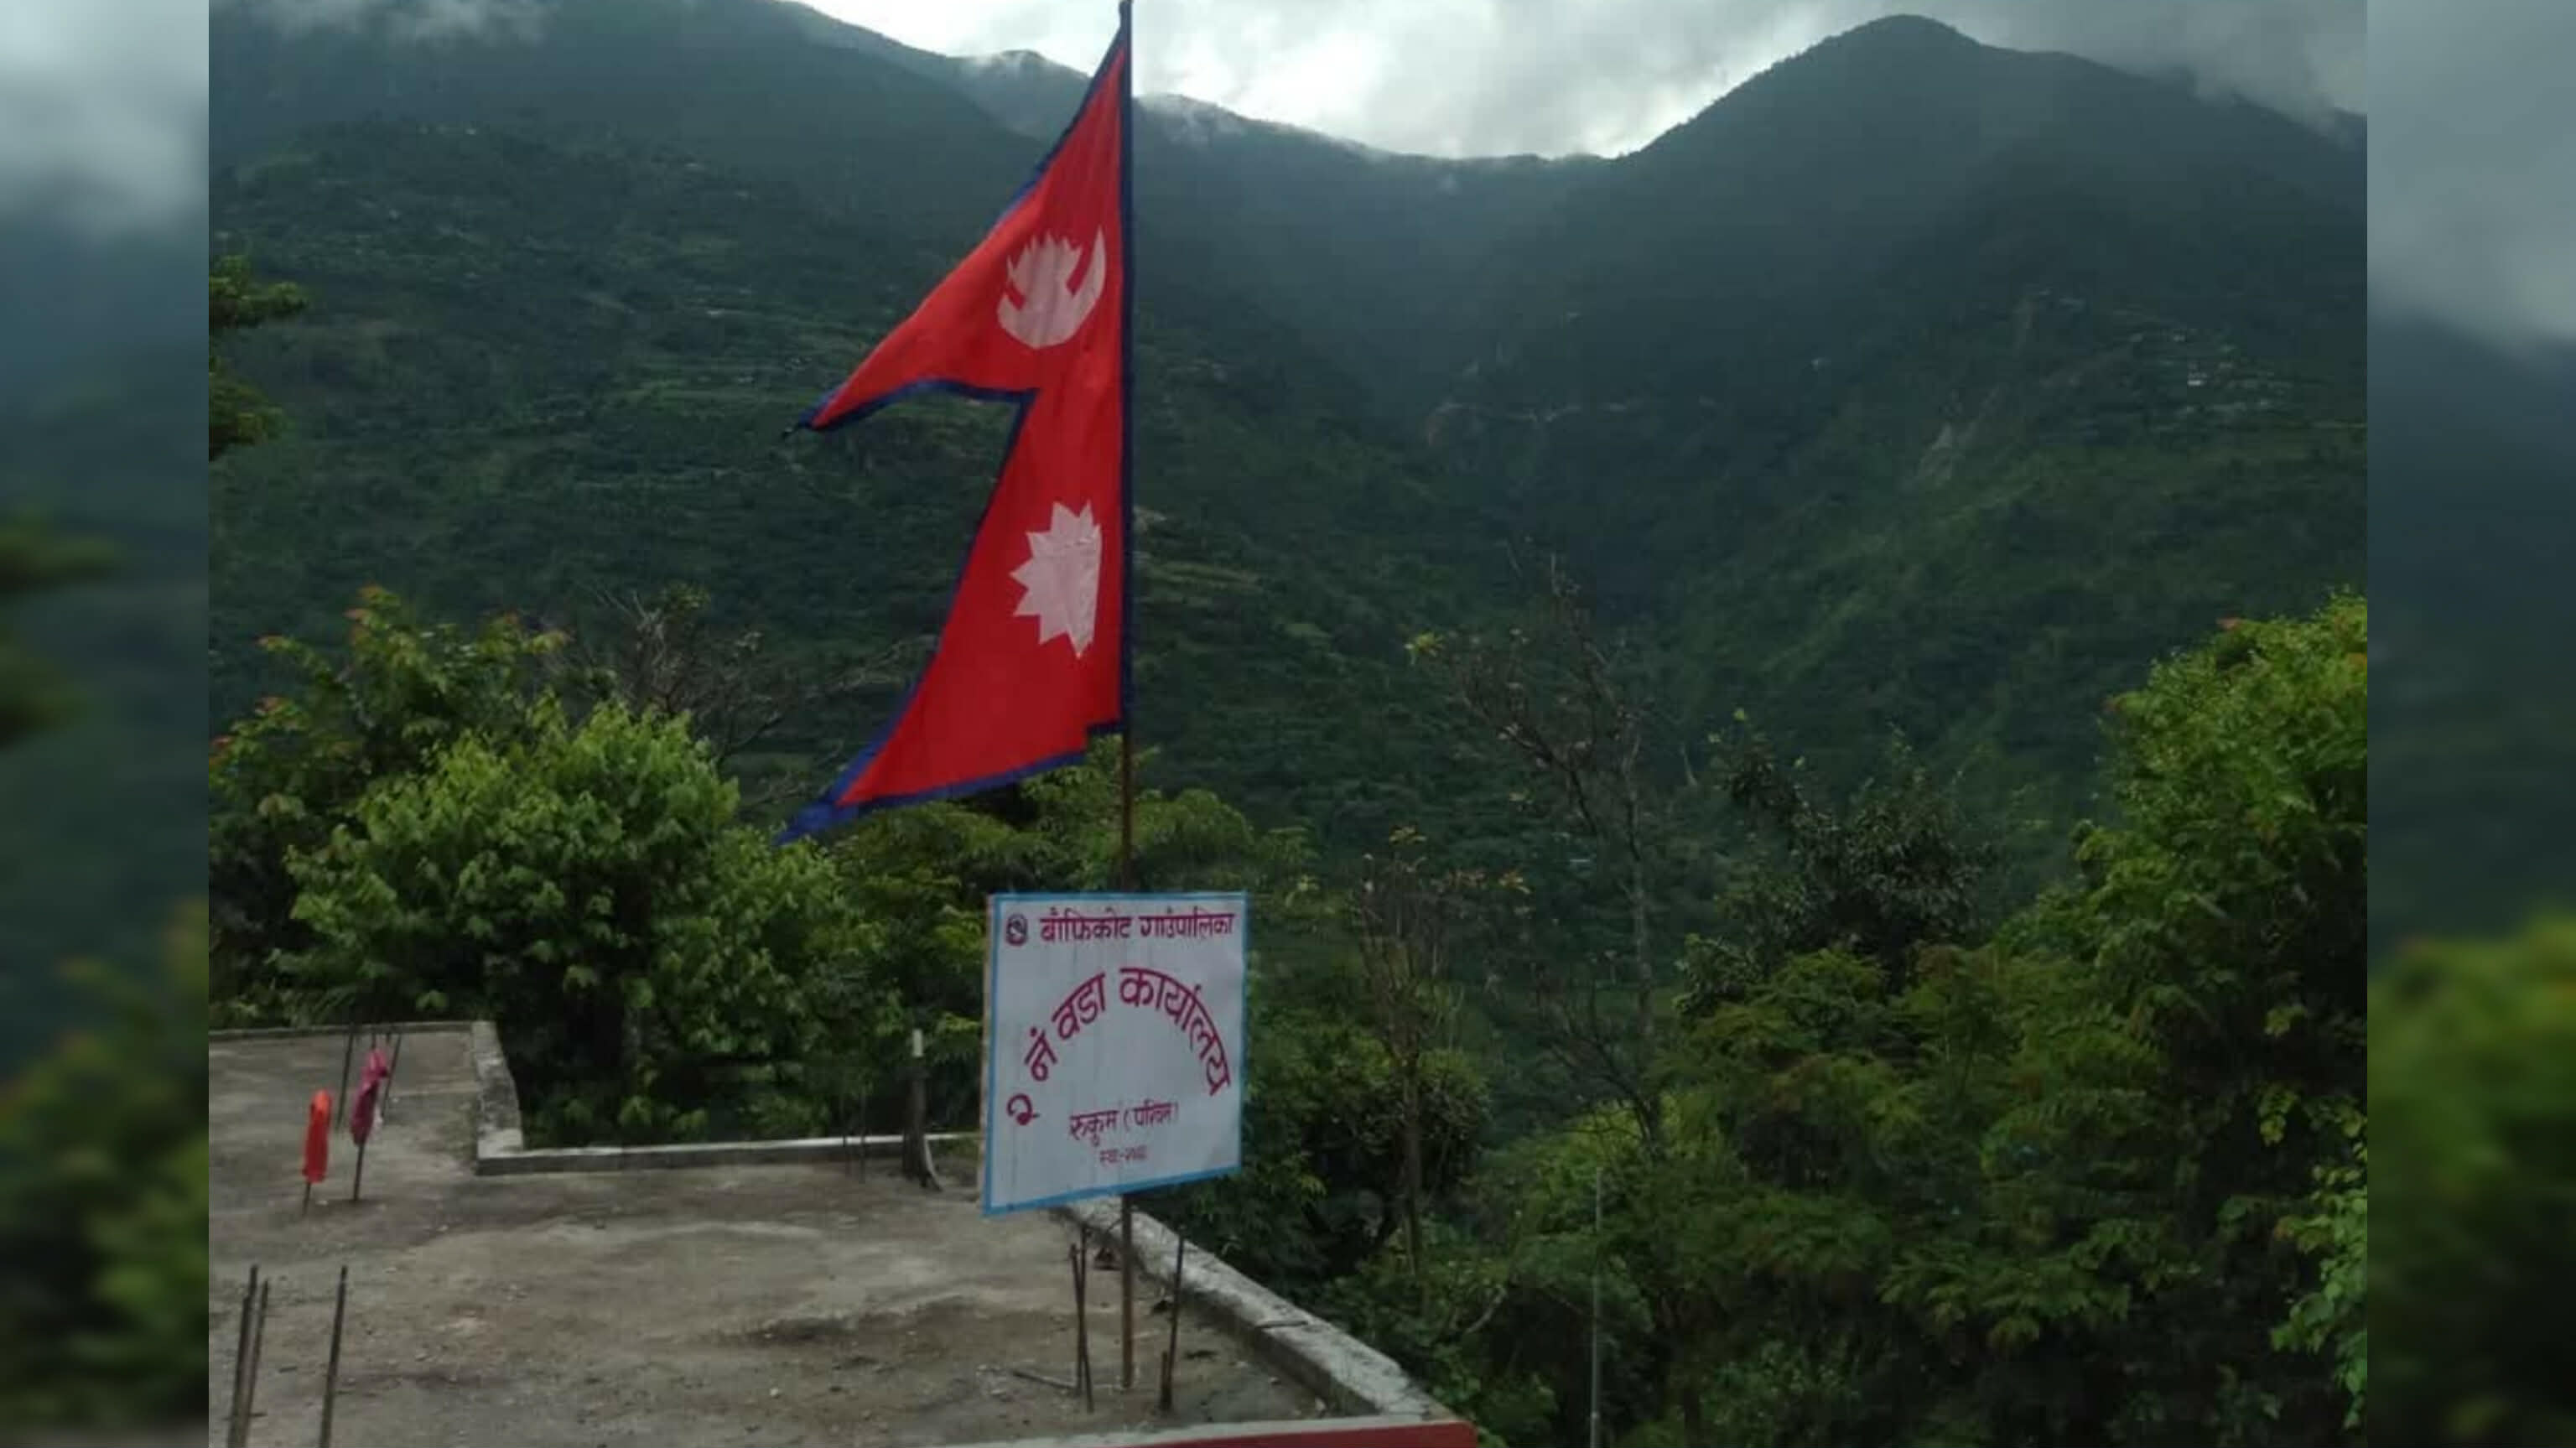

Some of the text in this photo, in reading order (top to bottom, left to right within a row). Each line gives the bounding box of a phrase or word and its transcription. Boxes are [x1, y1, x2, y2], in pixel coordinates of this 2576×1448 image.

[1006, 1093, 1039, 1124] २
[1052, 973, 1105, 1040] वडा
[1119, 968, 1231, 1096] कार्यालय
